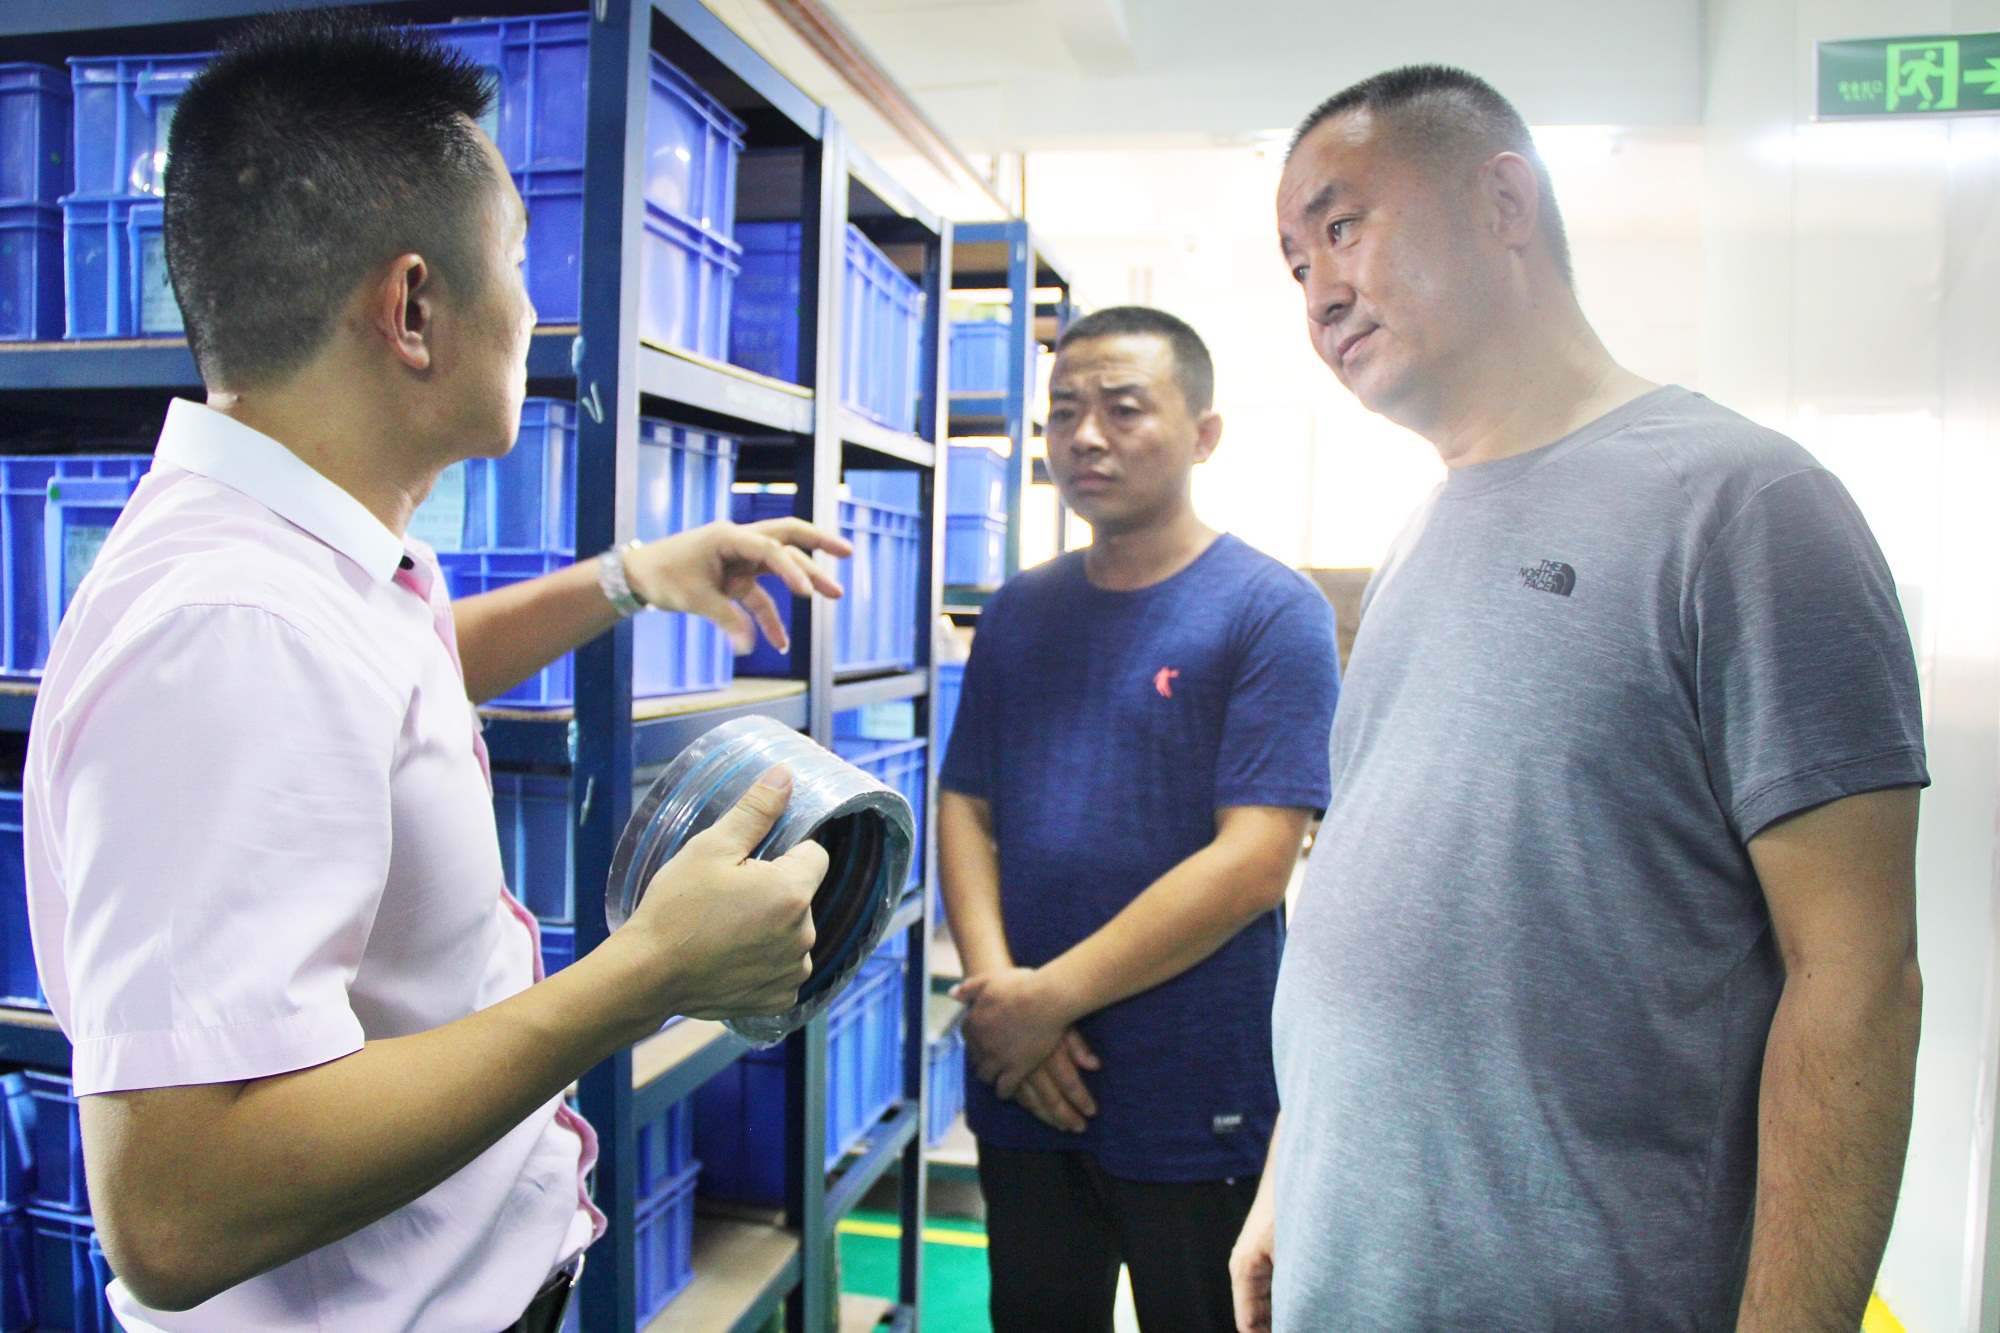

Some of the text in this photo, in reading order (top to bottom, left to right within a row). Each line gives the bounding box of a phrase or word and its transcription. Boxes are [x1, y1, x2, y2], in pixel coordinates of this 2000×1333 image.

[1540, 559, 1562, 572] THE
[1518, 567, 1556, 582] NORTH
[1523, 578, 1552, 592] FACE
